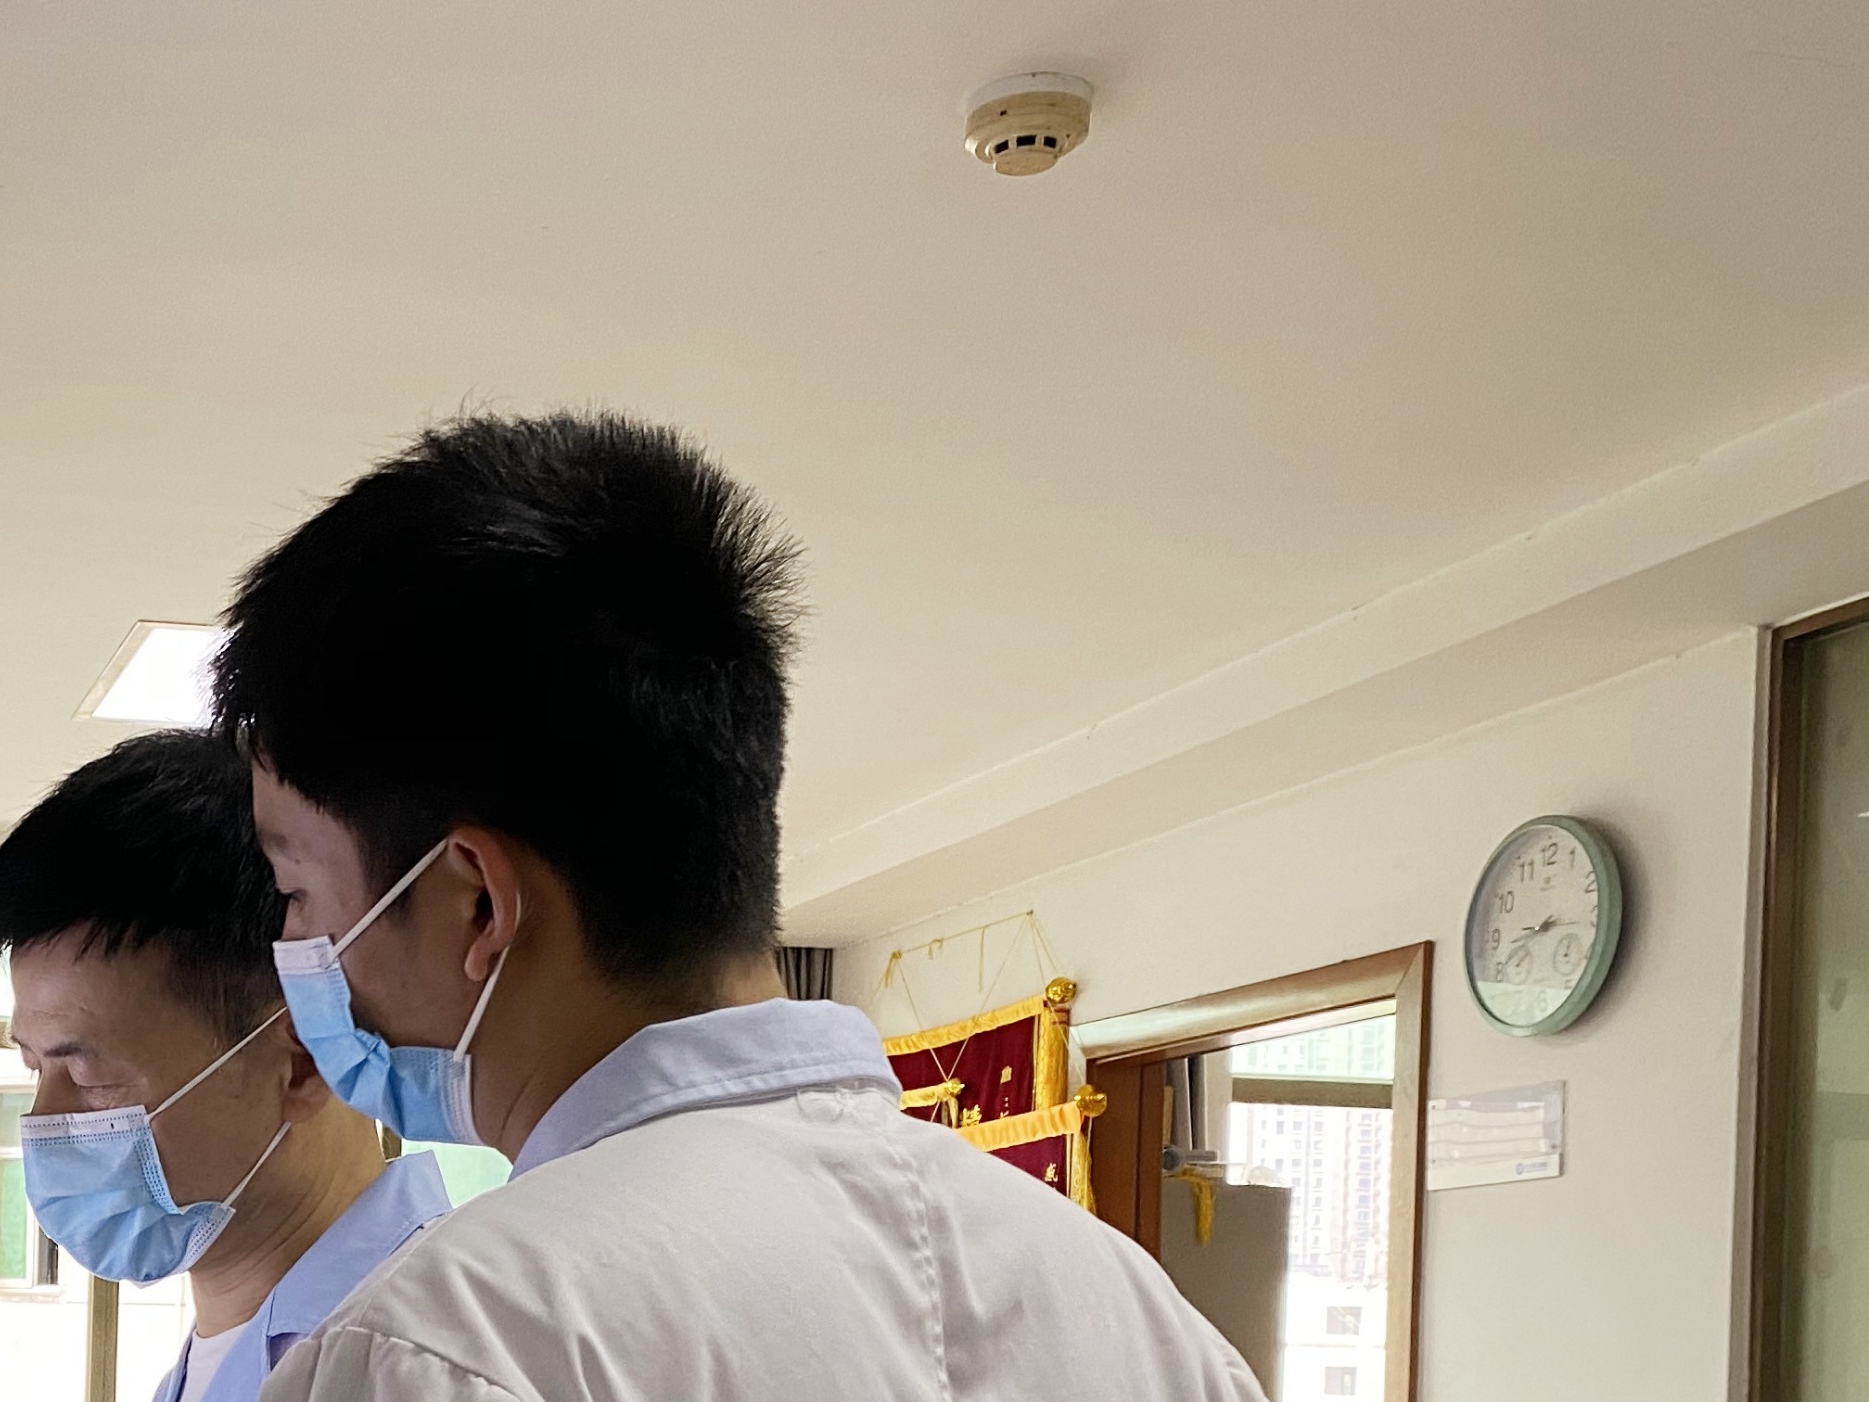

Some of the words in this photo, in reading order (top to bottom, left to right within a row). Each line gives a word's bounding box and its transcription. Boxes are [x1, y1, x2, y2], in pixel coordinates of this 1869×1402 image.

[1540, 842, 1559, 868] 12
[1568, 847, 1577, 869] 1
[1519, 858, 1535, 884] 11
[1584, 870, 1597, 894] 2
[1497, 890, 1515, 915] 10
[1491, 928, 1502, 951] 9
